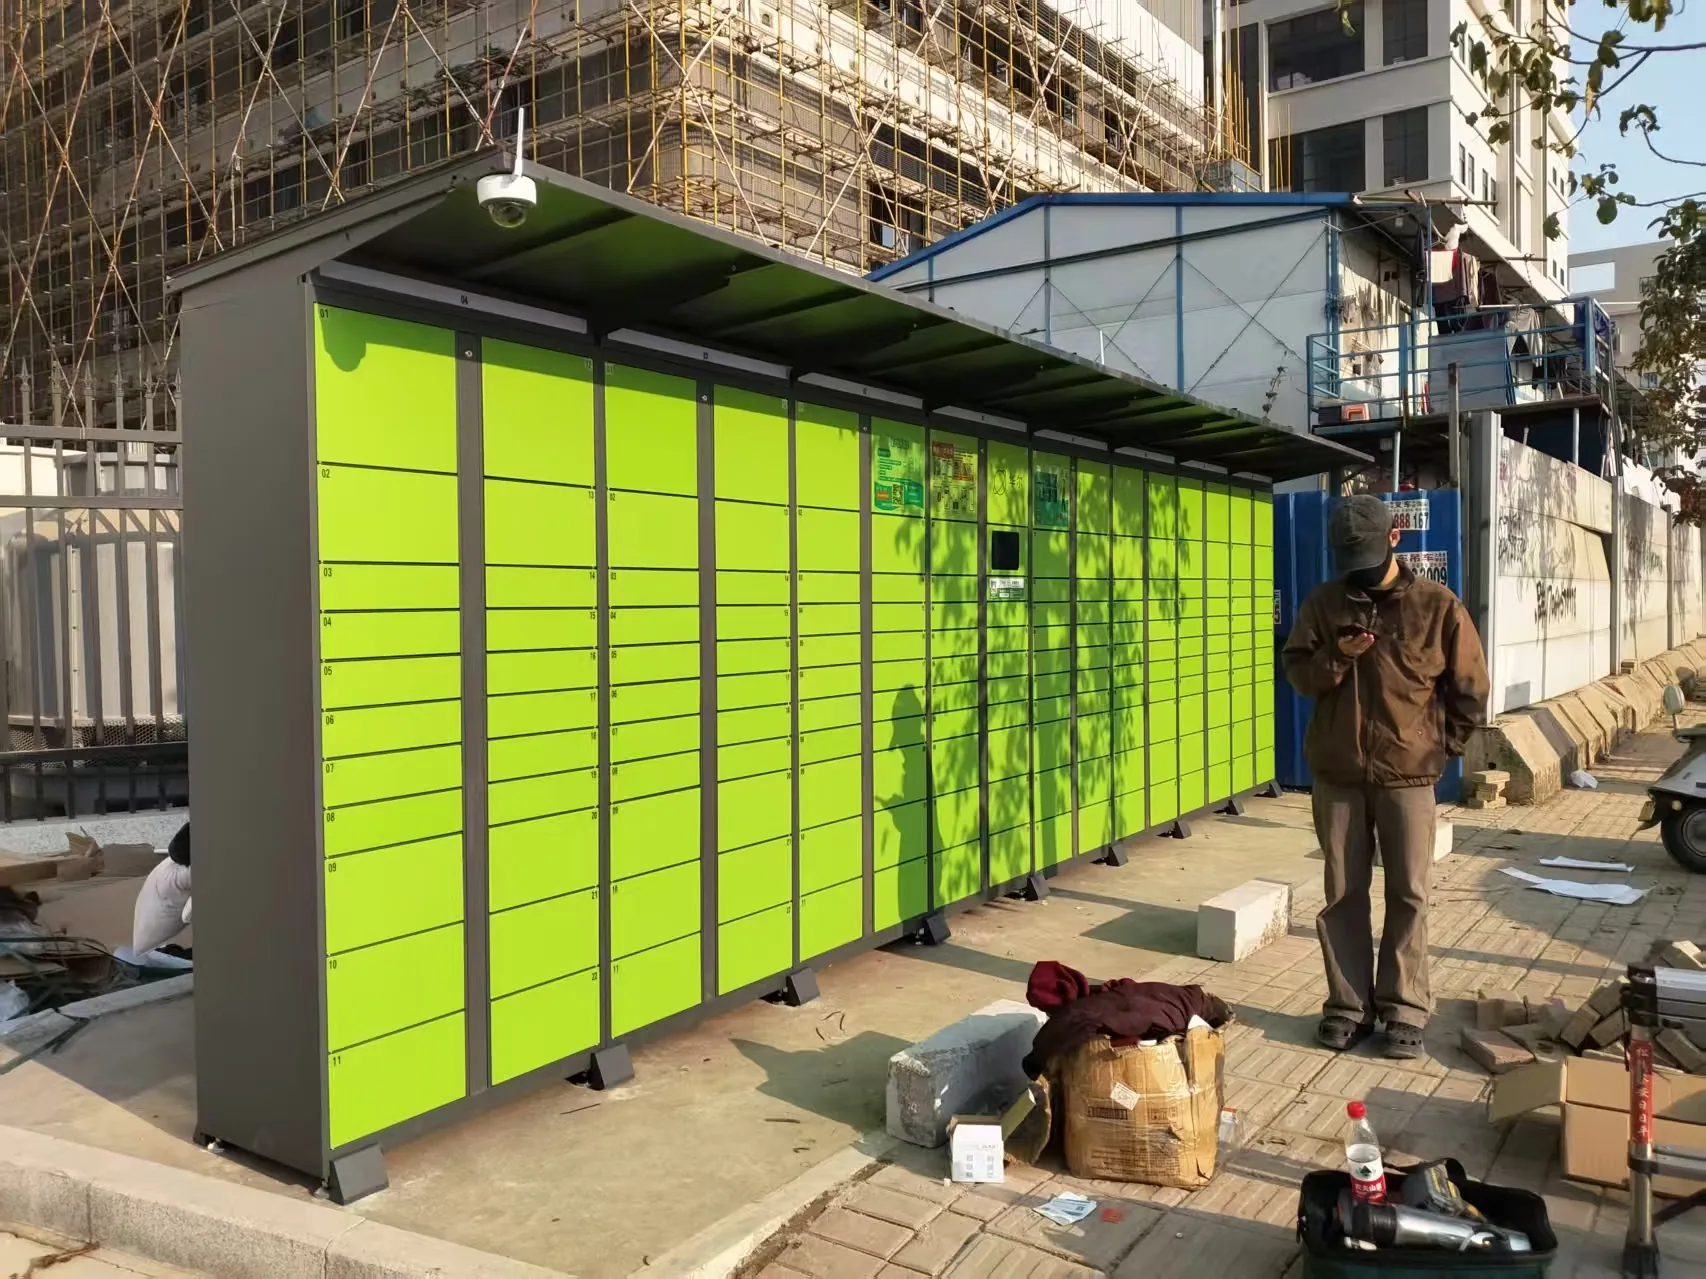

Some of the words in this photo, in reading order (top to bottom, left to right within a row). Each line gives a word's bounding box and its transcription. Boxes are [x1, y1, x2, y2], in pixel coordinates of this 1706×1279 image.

[319, 309, 329, 318] 01
[322, 469, 330, 478] 02
[1413, 511, 1429, 529] 167
[323, 568, 332, 577] 03
[323, 617, 332, 627] 04
[324, 666, 332, 676] 05
[325, 715, 334, 725] 06
[325, 764, 334, 773] 07
[326, 813, 335, 823] 08
[328, 863, 337, 873] 09
[329, 960, 337, 969] 10
[333, 1056, 341, 1066] 11
